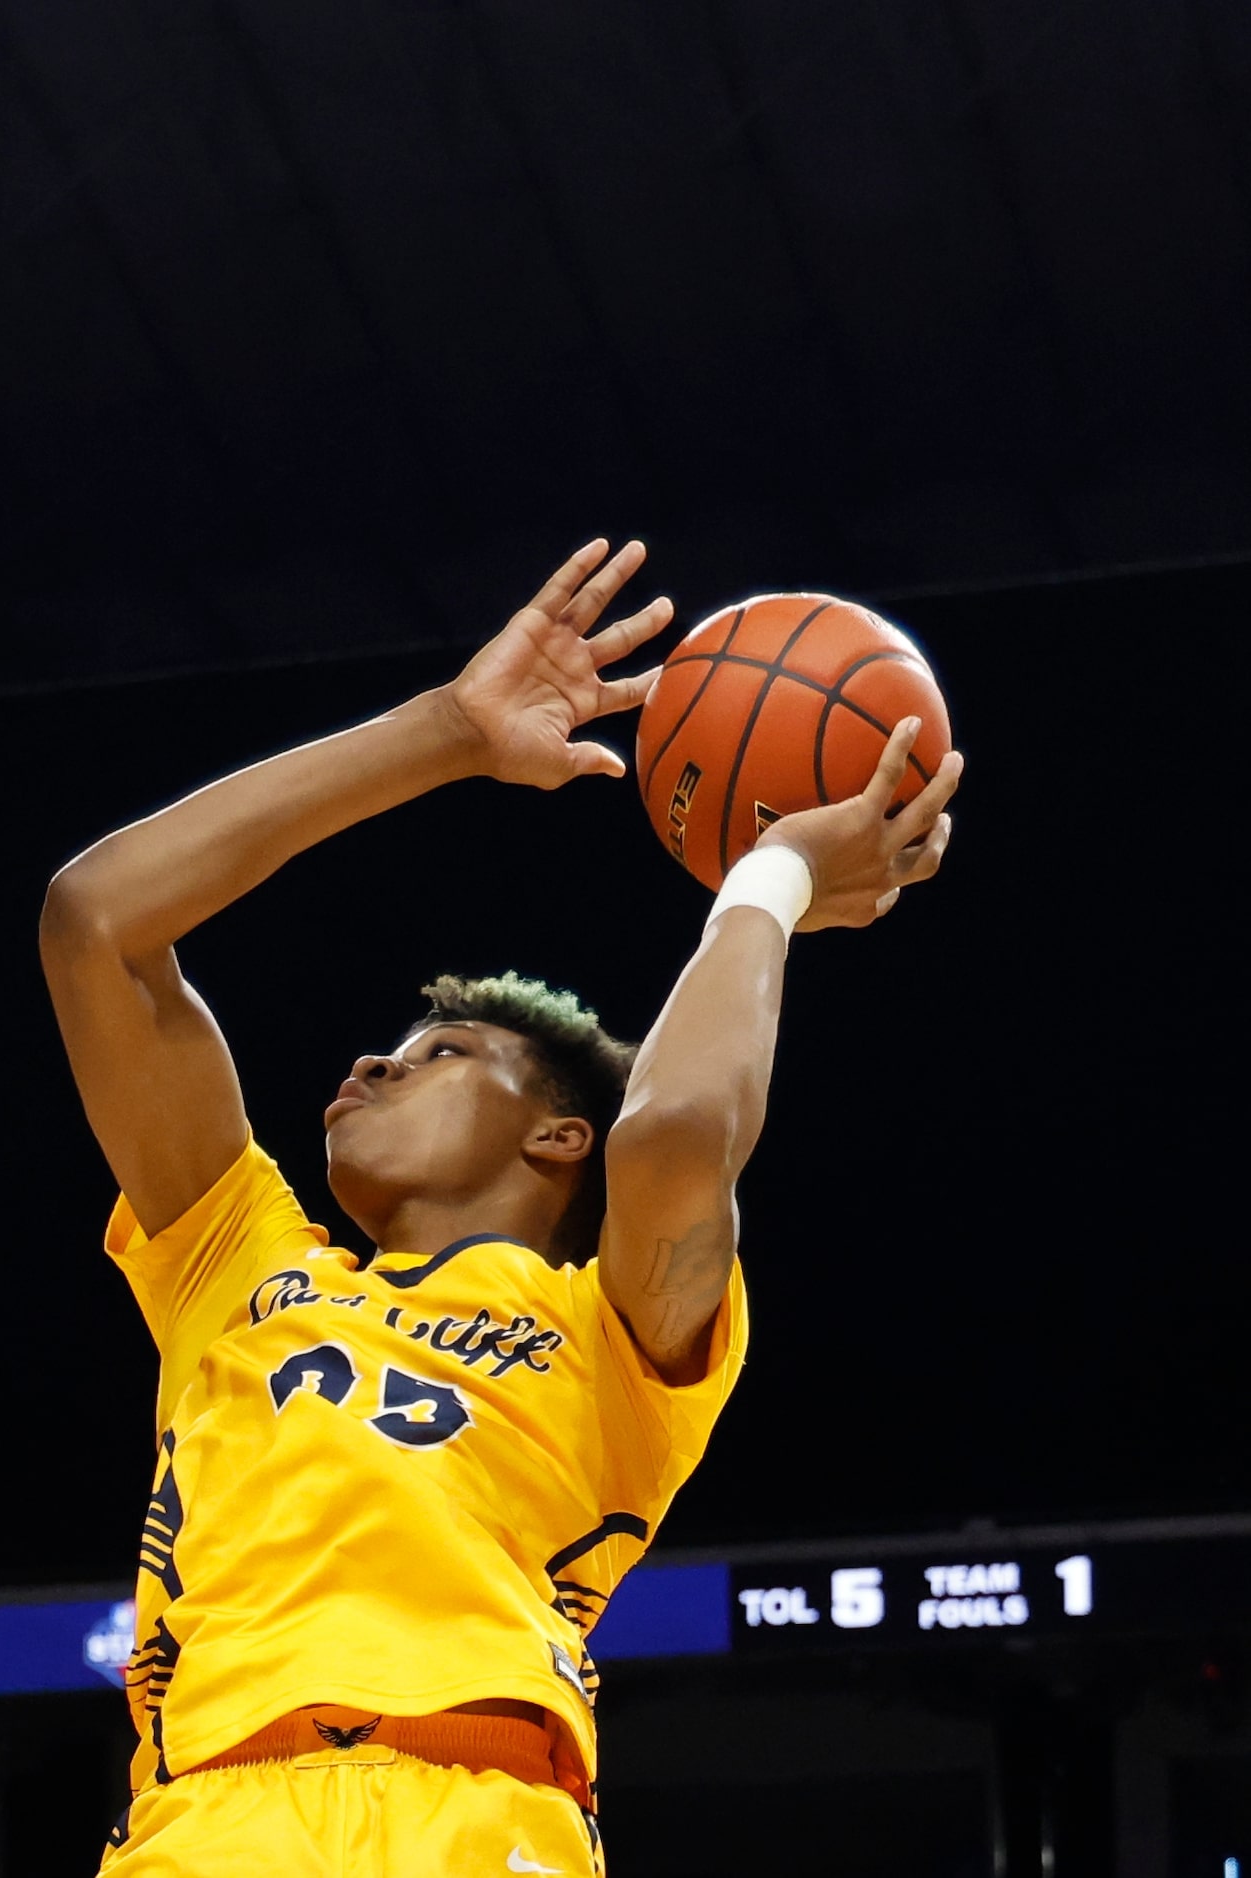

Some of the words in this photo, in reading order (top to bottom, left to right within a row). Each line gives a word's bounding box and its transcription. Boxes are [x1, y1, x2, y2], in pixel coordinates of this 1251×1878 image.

[667, 759, 703, 867] ELIT
[739, 1588, 817, 1626] TOL
[831, 1568, 883, 1628] 5
[925, 1563, 1019, 1594] TEAM
[1056, 1556, 1091, 1615] 1
[919, 1597, 1028, 1629] FOULS
